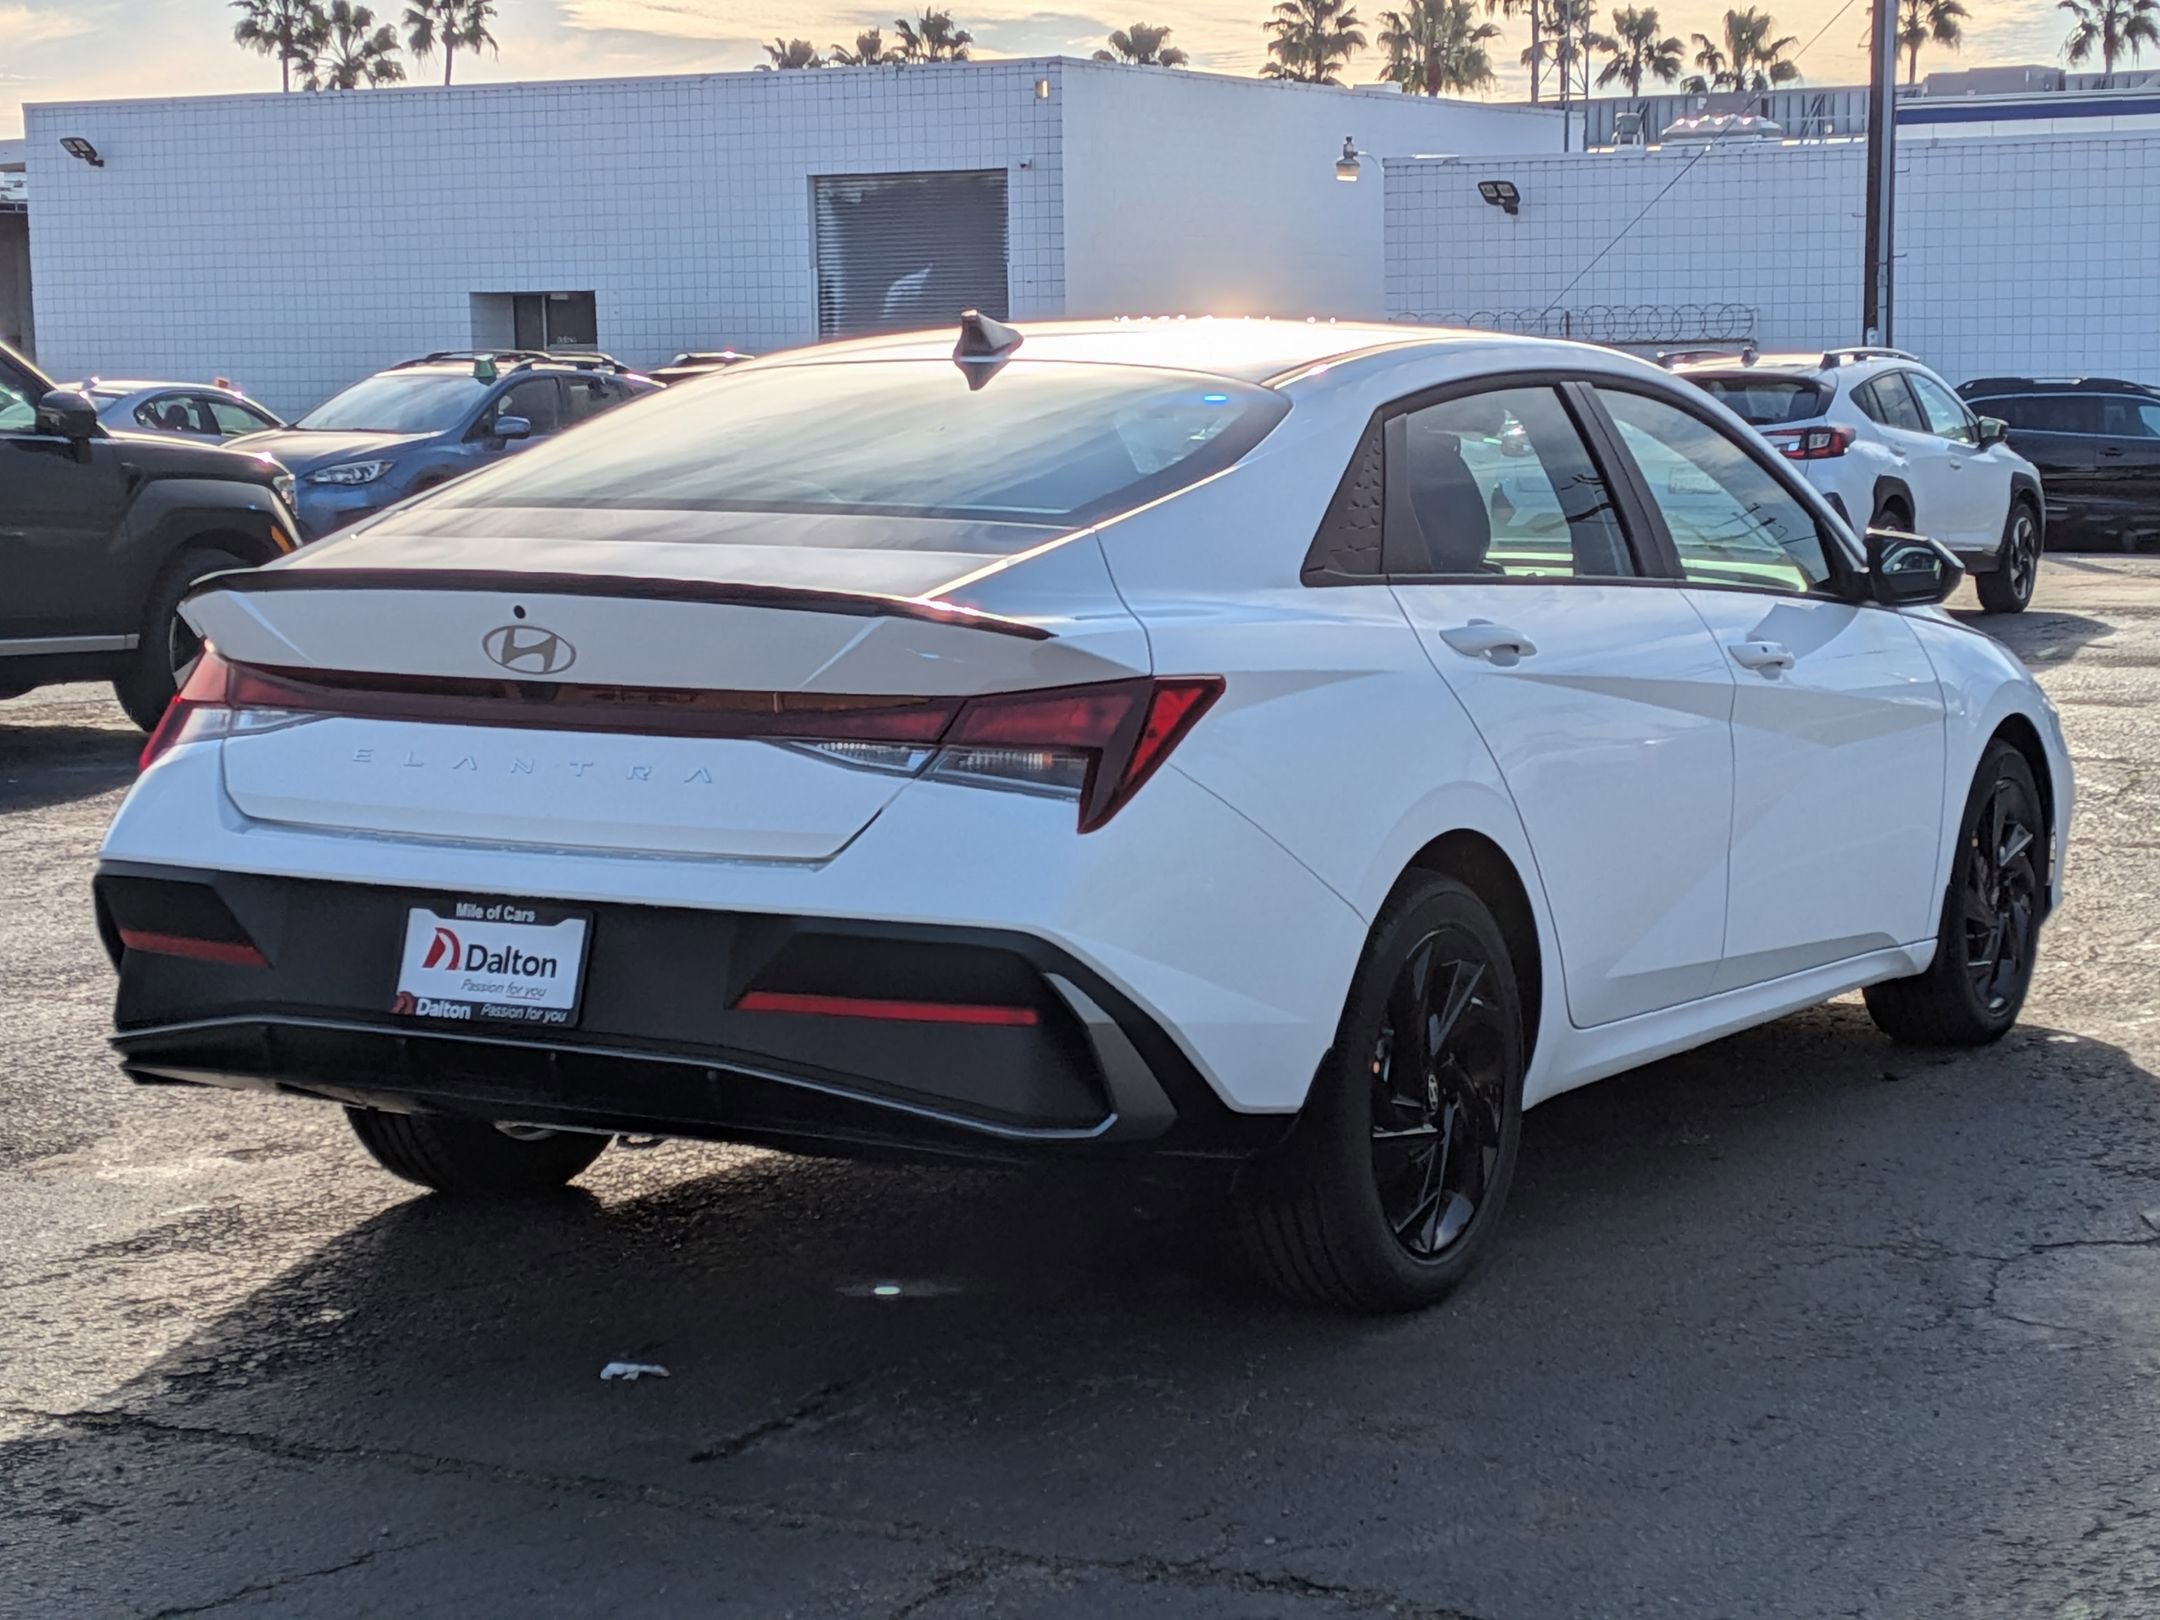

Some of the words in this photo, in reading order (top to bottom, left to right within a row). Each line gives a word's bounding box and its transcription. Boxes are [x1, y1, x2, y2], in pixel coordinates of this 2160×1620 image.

[352, 749, 713, 784] ELANTRA
[455, 902, 483, 918] Mile
[486, 904, 502, 919] of
[503, 905, 536, 922] Cars
[464, 944, 557, 978] Dalton
[461, 978, 503, 992] Passion
[505, 981, 523, 996] for
[523, 987, 547, 998] you
[416, 998, 472, 1020] Dalton
[480, 1003, 524, 1019] Passion
[524, 1006, 544, 1020] for
[542, 1011, 568, 1023] you
